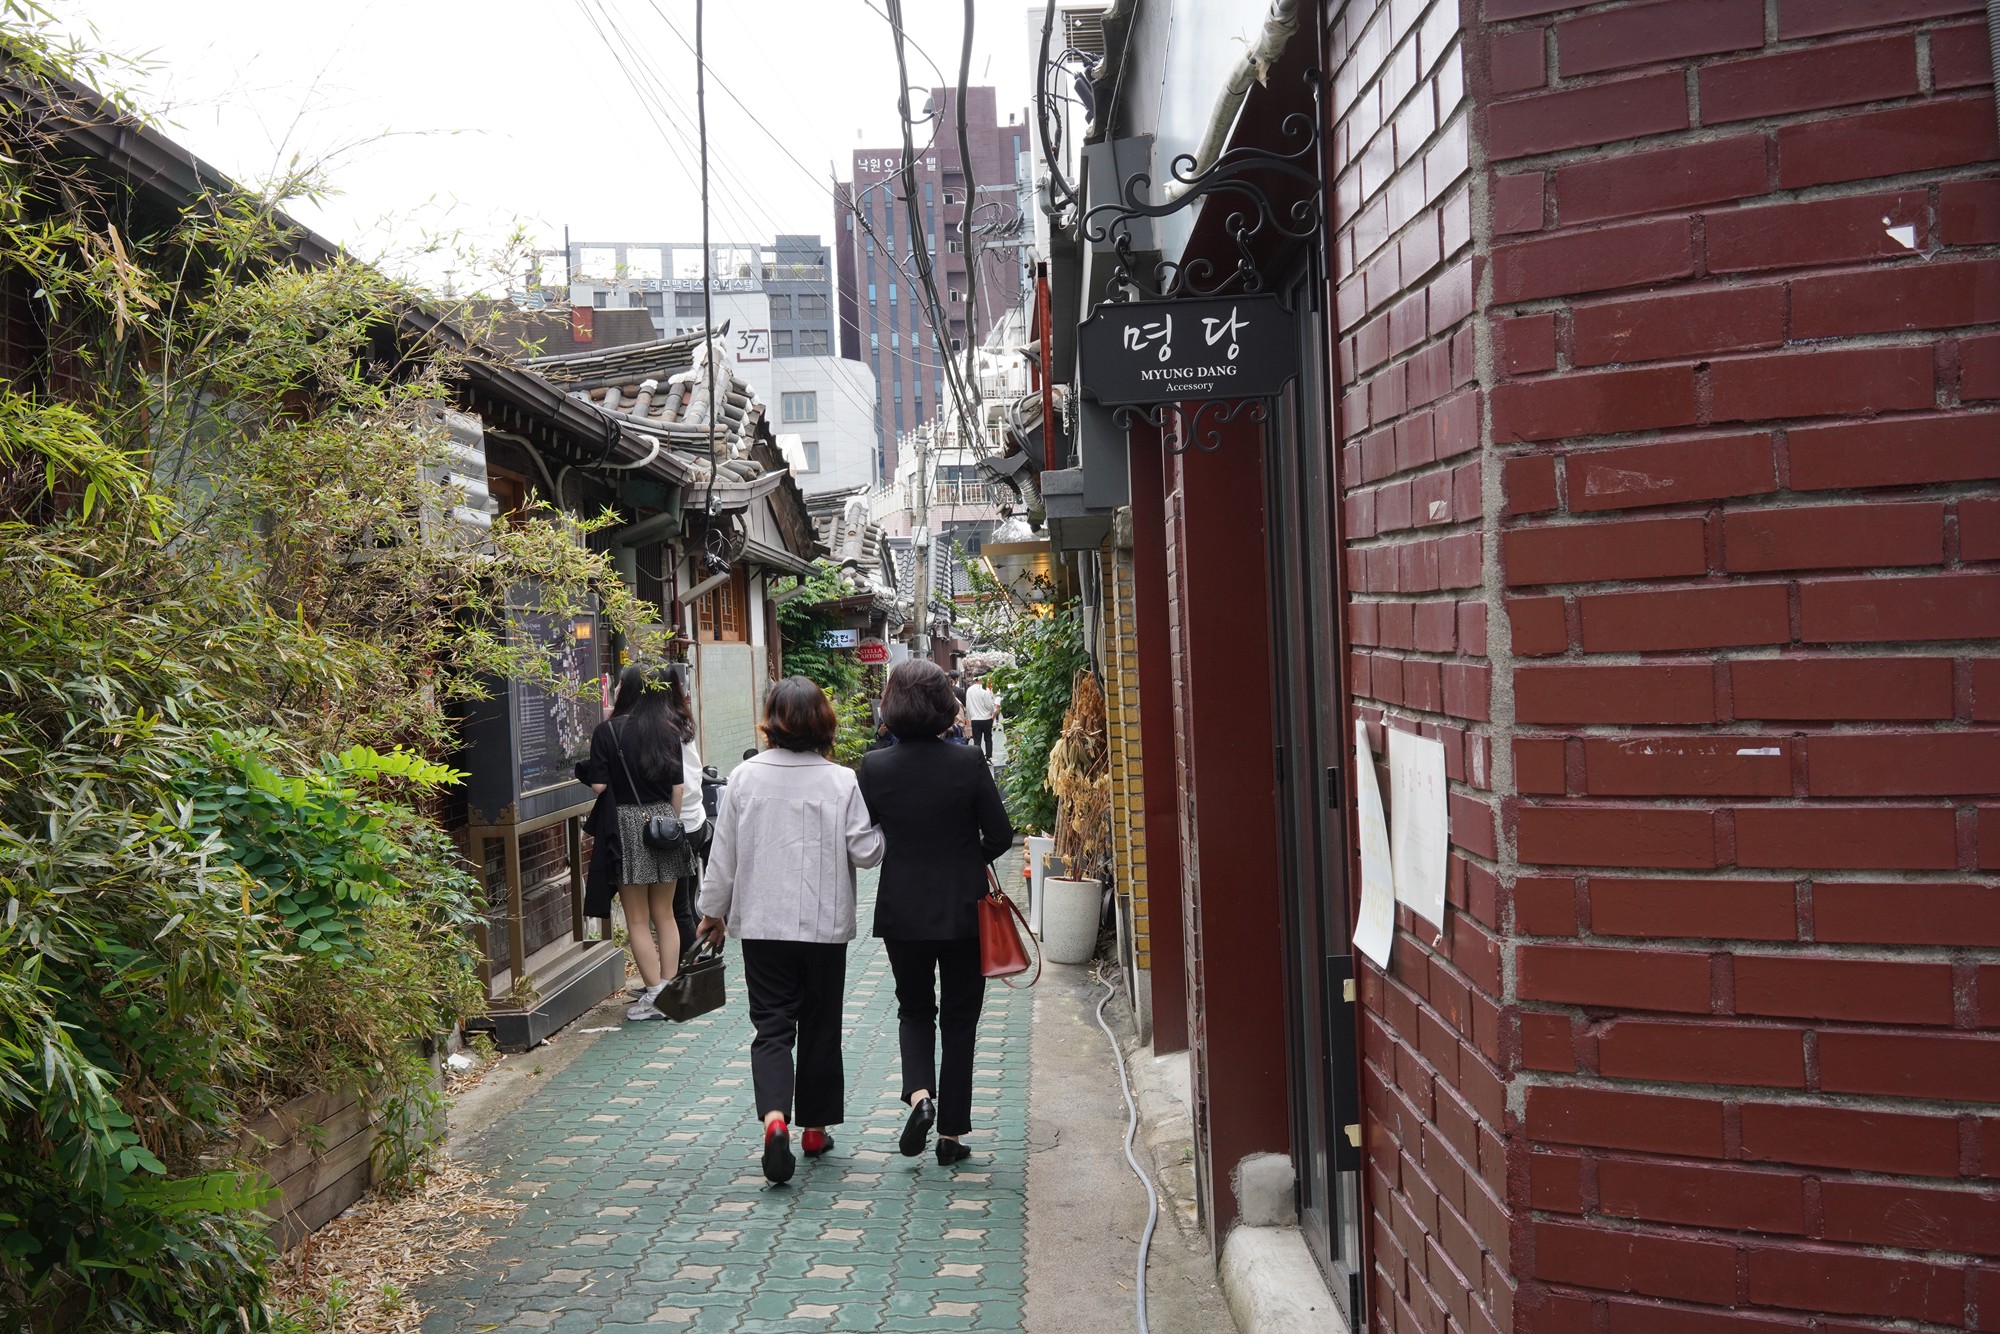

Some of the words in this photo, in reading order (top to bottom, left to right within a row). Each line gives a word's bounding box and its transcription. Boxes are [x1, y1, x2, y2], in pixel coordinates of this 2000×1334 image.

[712, 279, 754, 291] 오피스텔
[737, 330, 759, 354] 37
[1141, 366, 1194, 381] MYUNG
[1197, 365, 1237, 378] DANG
[1166, 382, 1214, 393] Accessory
